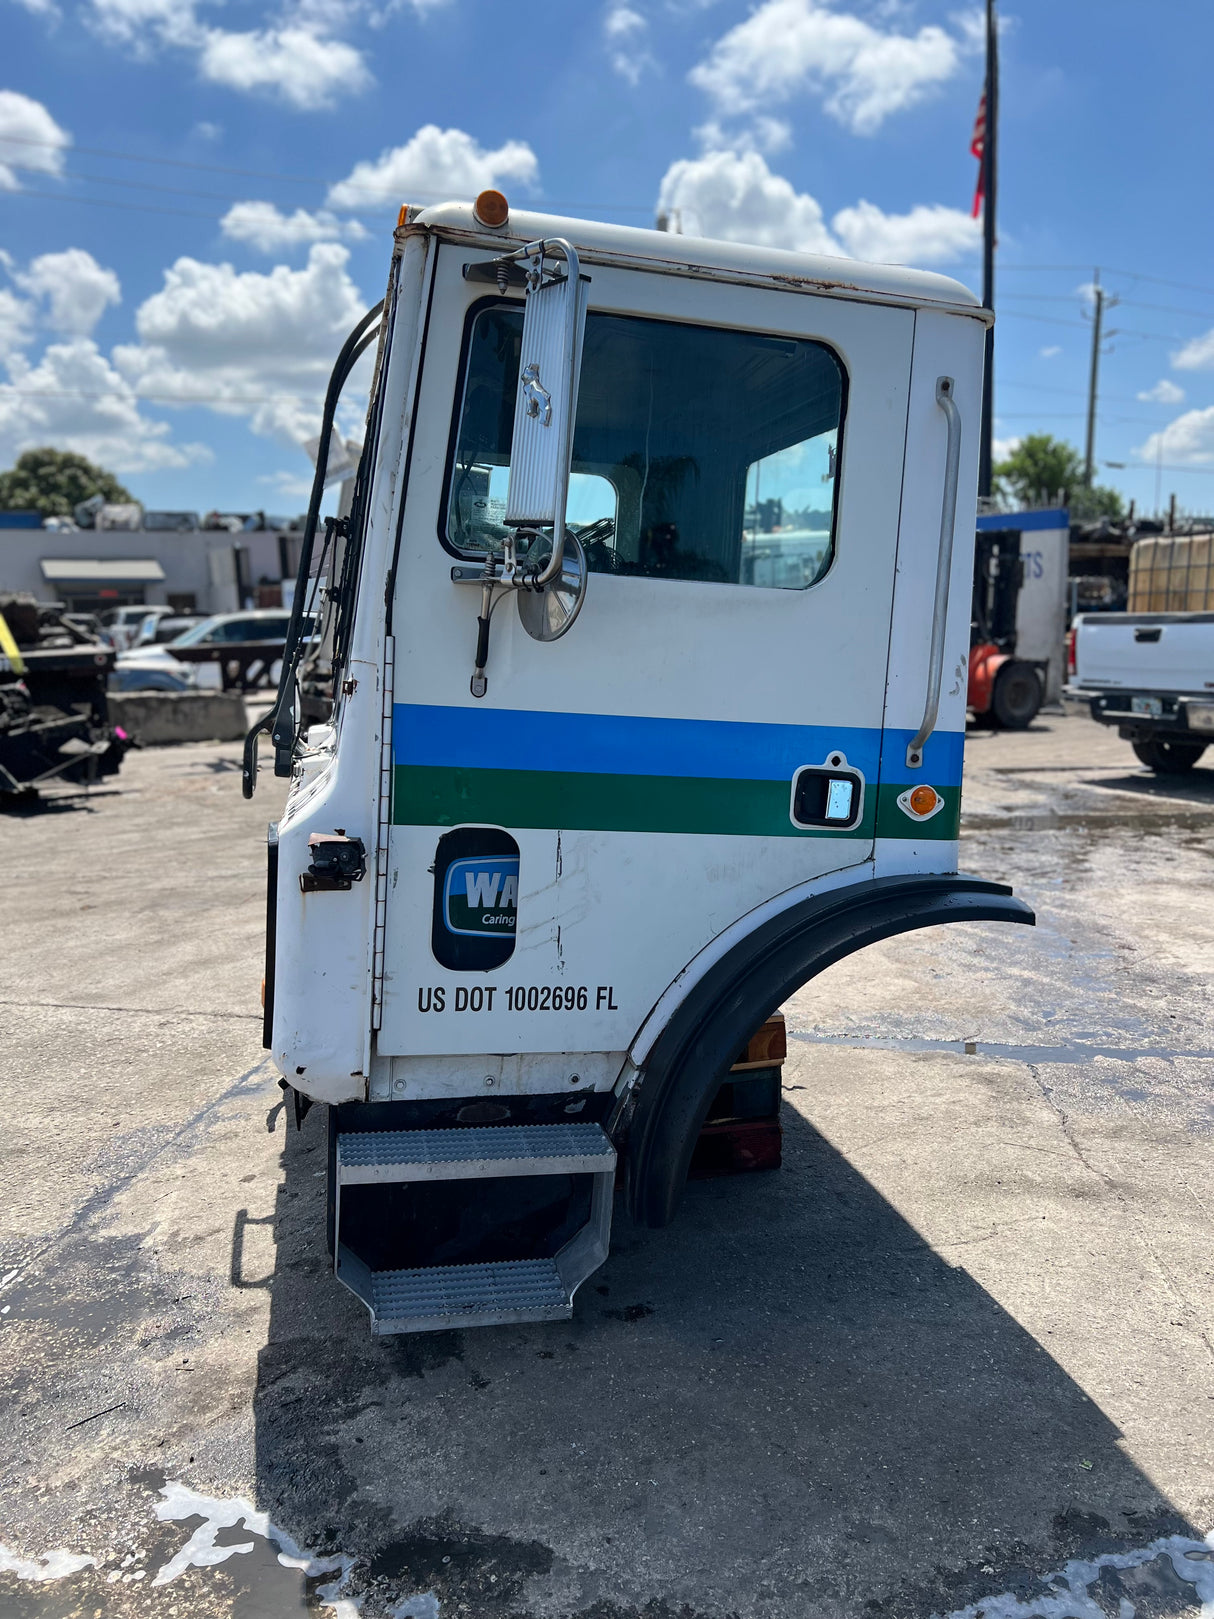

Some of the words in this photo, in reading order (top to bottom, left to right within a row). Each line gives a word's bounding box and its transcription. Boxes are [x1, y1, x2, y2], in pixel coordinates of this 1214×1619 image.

[465, 872, 518, 908] WA
[482, 914, 516, 927] Caring
[418, 987, 446, 1012] US
[455, 986, 497, 1012] DOT
[505, 986, 588, 1011] 1002696
[596, 986, 618, 1010] FL
